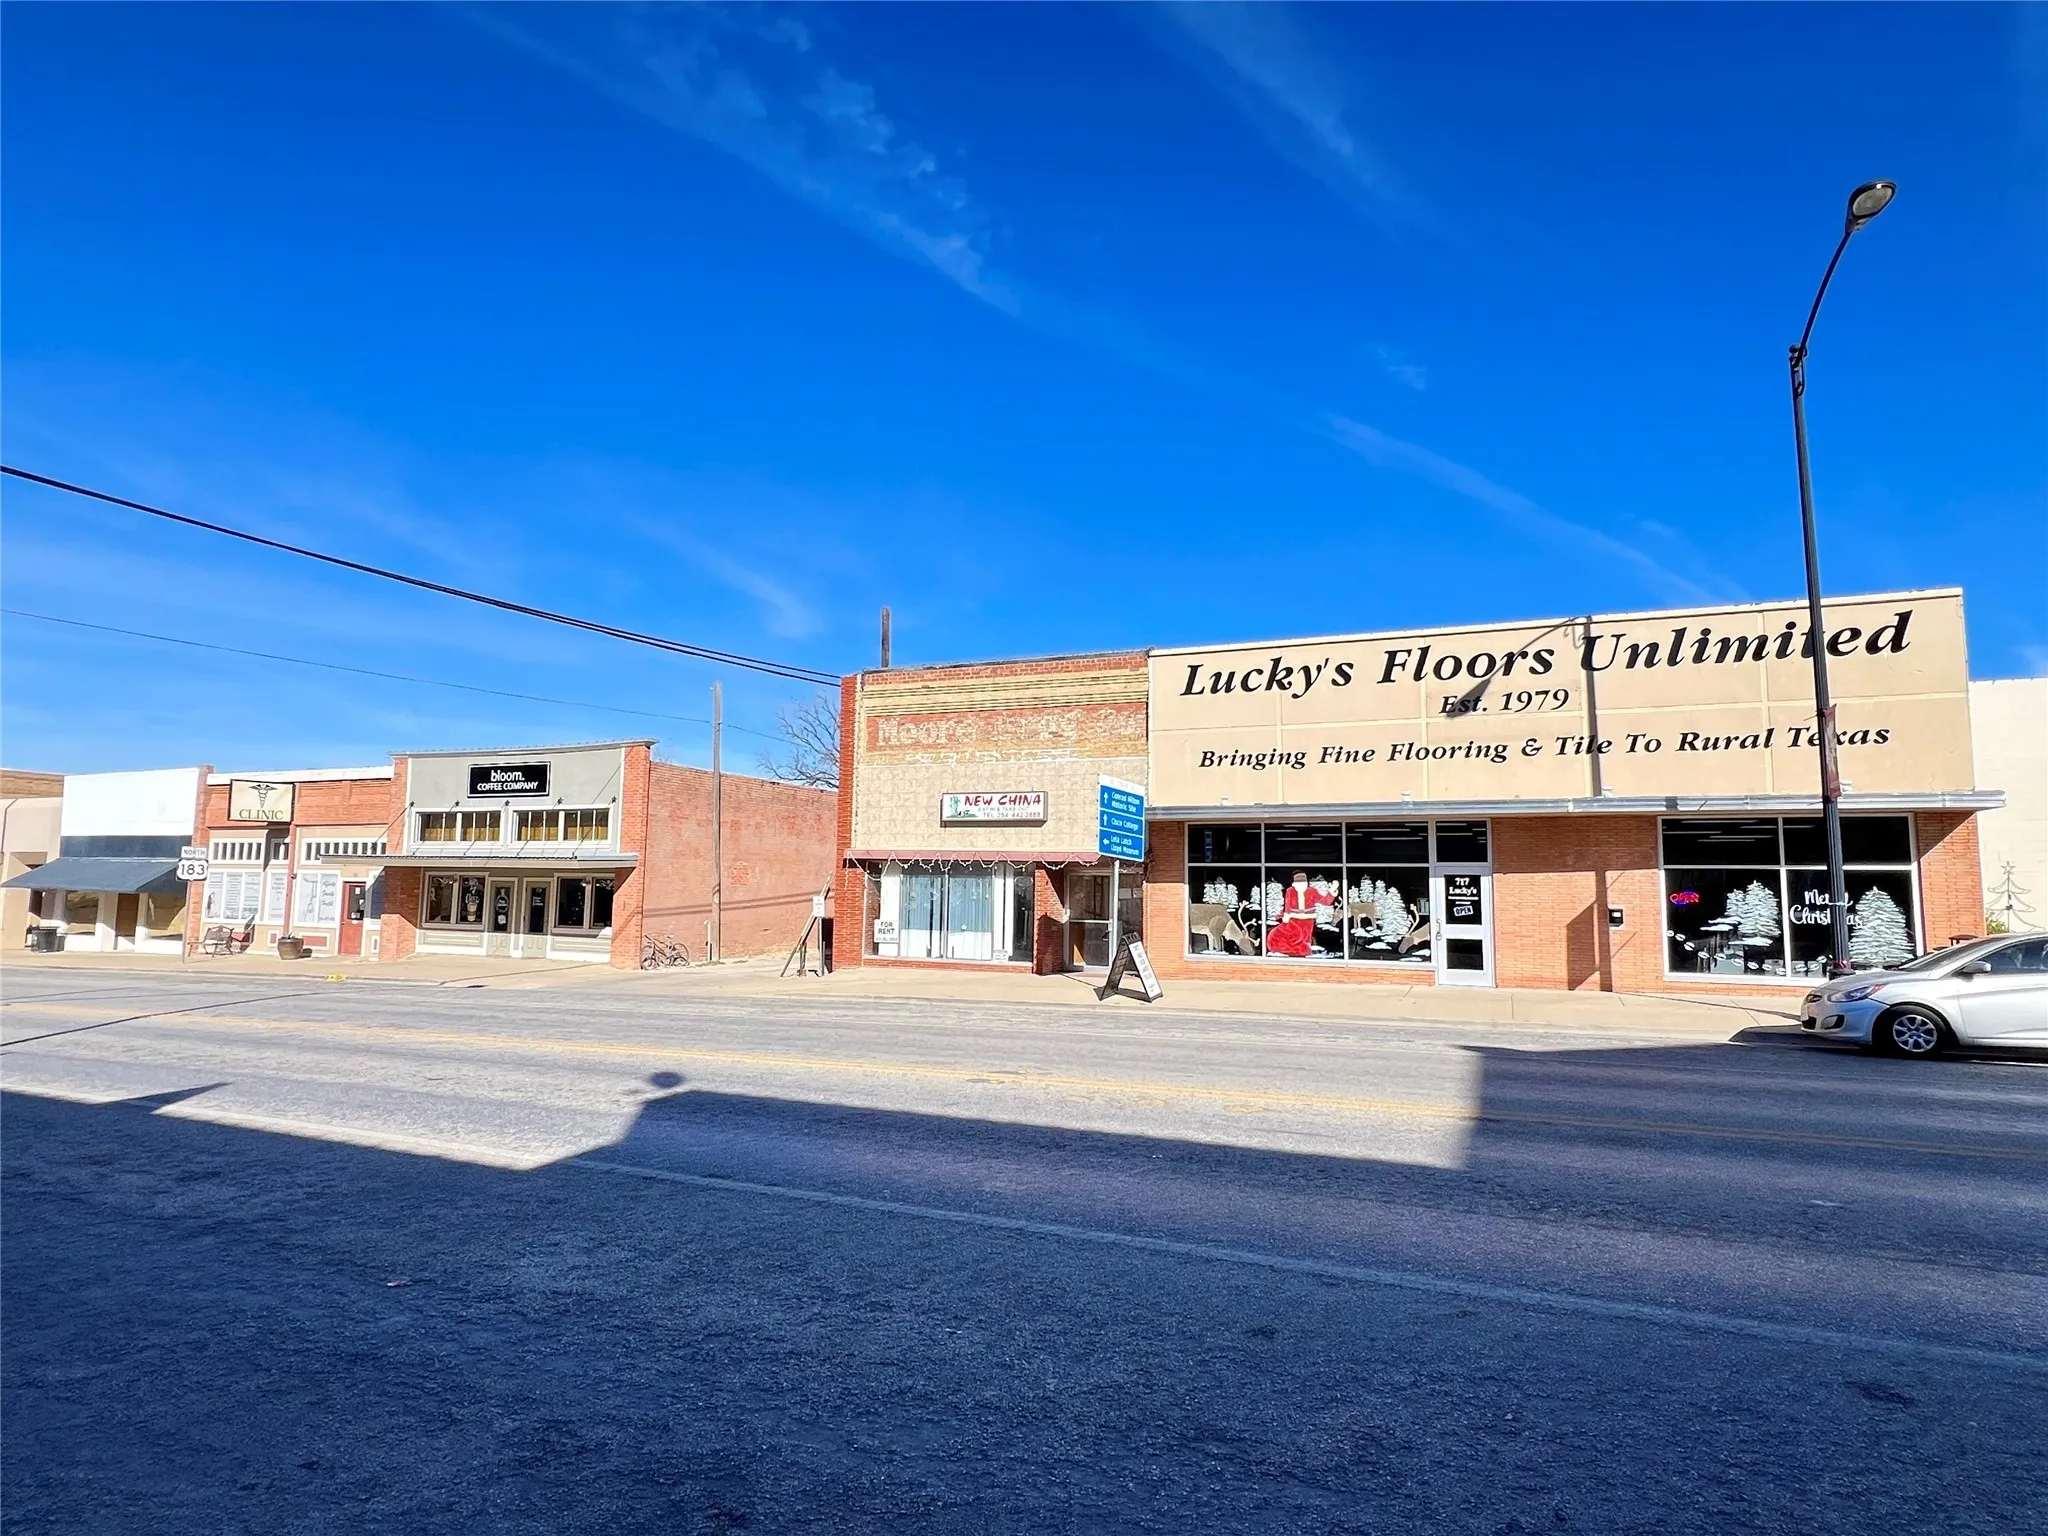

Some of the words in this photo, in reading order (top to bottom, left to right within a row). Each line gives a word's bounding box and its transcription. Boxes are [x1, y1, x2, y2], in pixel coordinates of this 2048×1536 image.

[1179, 656, 1354, 699] Lucky's
[1376, 645, 1555, 684] Floors
[1438, 695, 1488, 715] Est.
[1499, 688, 1570, 713] 1979
[1198, 748, 1307, 771] Bringing
[1318, 746, 1376, 764] Fine
[1386, 741, 1508, 763] Flooring
[1521, 738, 1543, 757] &
[1555, 735, 1613, 756] Tile
[1625, 733, 1662, 753] To
[1675, 727, 1774, 752] Rural
[477, 782, 503, 791] COFFEE
[503, 781, 539, 790] COMPANY
[964, 795, 993, 806] NEW
[998, 794, 1041, 805] CHINA
[239, 808, 284, 820] CLINIC
[183, 848, 205, 856] NORTH
[181, 864, 205, 876] 183
[1454, 877, 1470, 886] 717
[1456, 907, 1472, 915] OPEN
